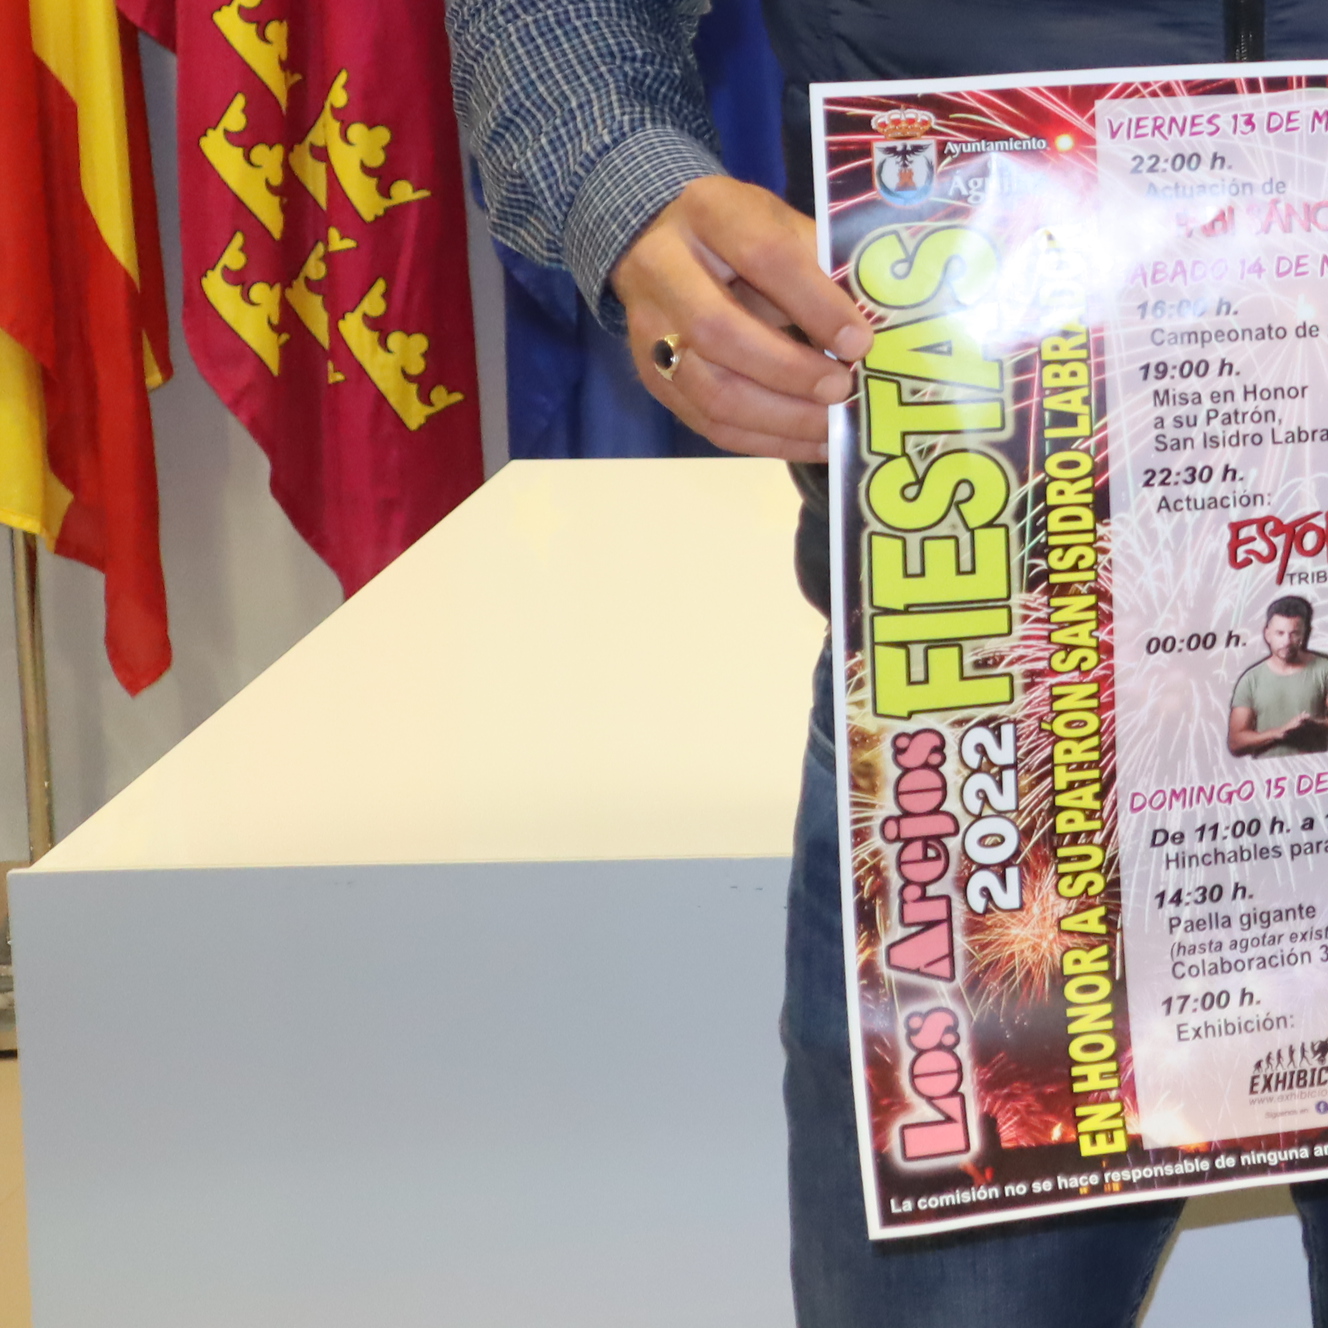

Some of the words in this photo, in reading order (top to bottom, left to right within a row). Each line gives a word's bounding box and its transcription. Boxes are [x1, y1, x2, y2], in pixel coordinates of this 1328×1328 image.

[944, 138, 1047, 158] Ayuntamiento
[1107, 115, 1221, 141] VIERNES
[1231, 113, 1255, 136] 13
[1266, 111, 1300, 133] DE
[855, 224, 1016, 720] FIESTAS
[1046, 449, 1097, 587] ISIDRO
[1157, 490, 1272, 514] Actuación:
[1049, 594, 1099, 674] SAN
[1041, 681, 1103, 833] PATRÓN
[961, 721, 1024, 916] 2022
[1129, 779, 1255, 814] DOMINGO
[1264, 778, 1287, 801] 15
[880, 727, 959, 982] Arejos
[1056, 845, 1107, 900] SU
[1165, 840, 1283, 870] Hinchables
[1060, 906, 1109, 936] A
[1169, 911, 1232, 935] Paella
[1239, 902, 1317, 932] gigante
[1063, 944, 1123, 1093] HONOR
[1176, 1013, 1295, 1043] Exhibición:
[900, 1006, 971, 1163] Los
[1074, 1102, 1128, 1158] EN
